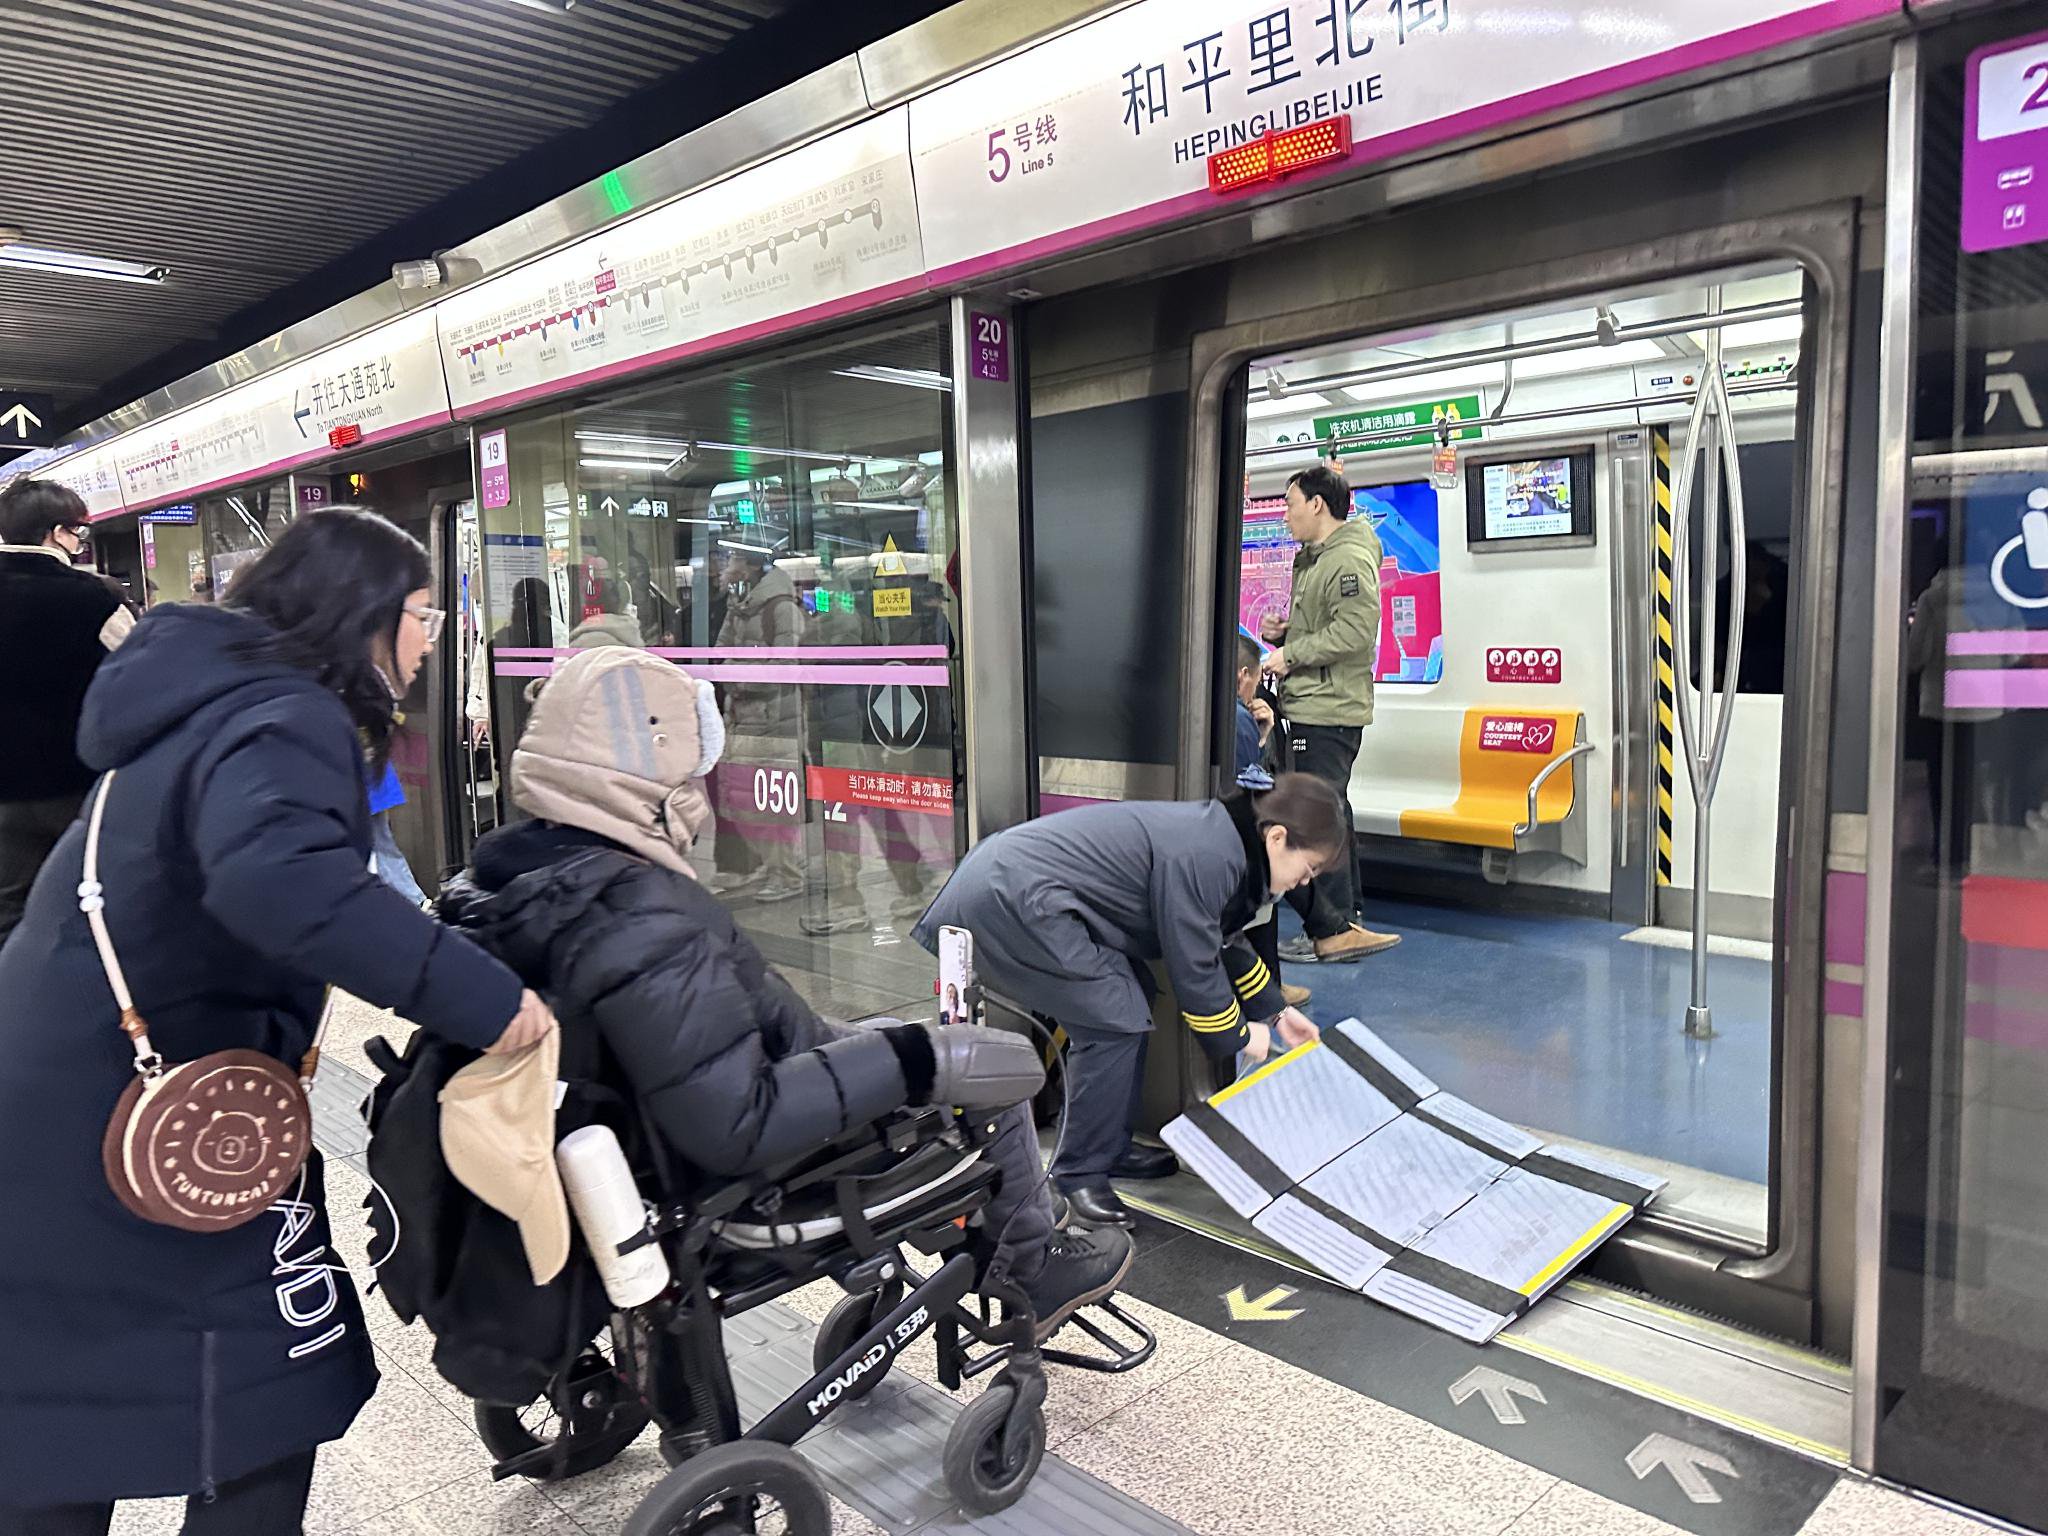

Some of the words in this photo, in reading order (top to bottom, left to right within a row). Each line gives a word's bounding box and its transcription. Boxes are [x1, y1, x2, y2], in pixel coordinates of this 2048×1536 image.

[1174, 74, 1383, 164] HEPINGLIBEIJIE
[988, 114, 1058, 183] 5号线
[1021, 157, 1045, 175] Line
[1047, 152, 1054, 167] 5
[978, 317, 1002, 344] 20
[312, 354, 395, 416] 开往天通苑北
[366, 403, 383, 418] North
[487, 441, 500, 461] 19
[305, 487, 321, 501] 19
[1484, 732, 1523, 740] COURTESY
[1485, 720, 1524, 733] 爱心座椅
[754, 768, 799, 816] 050
